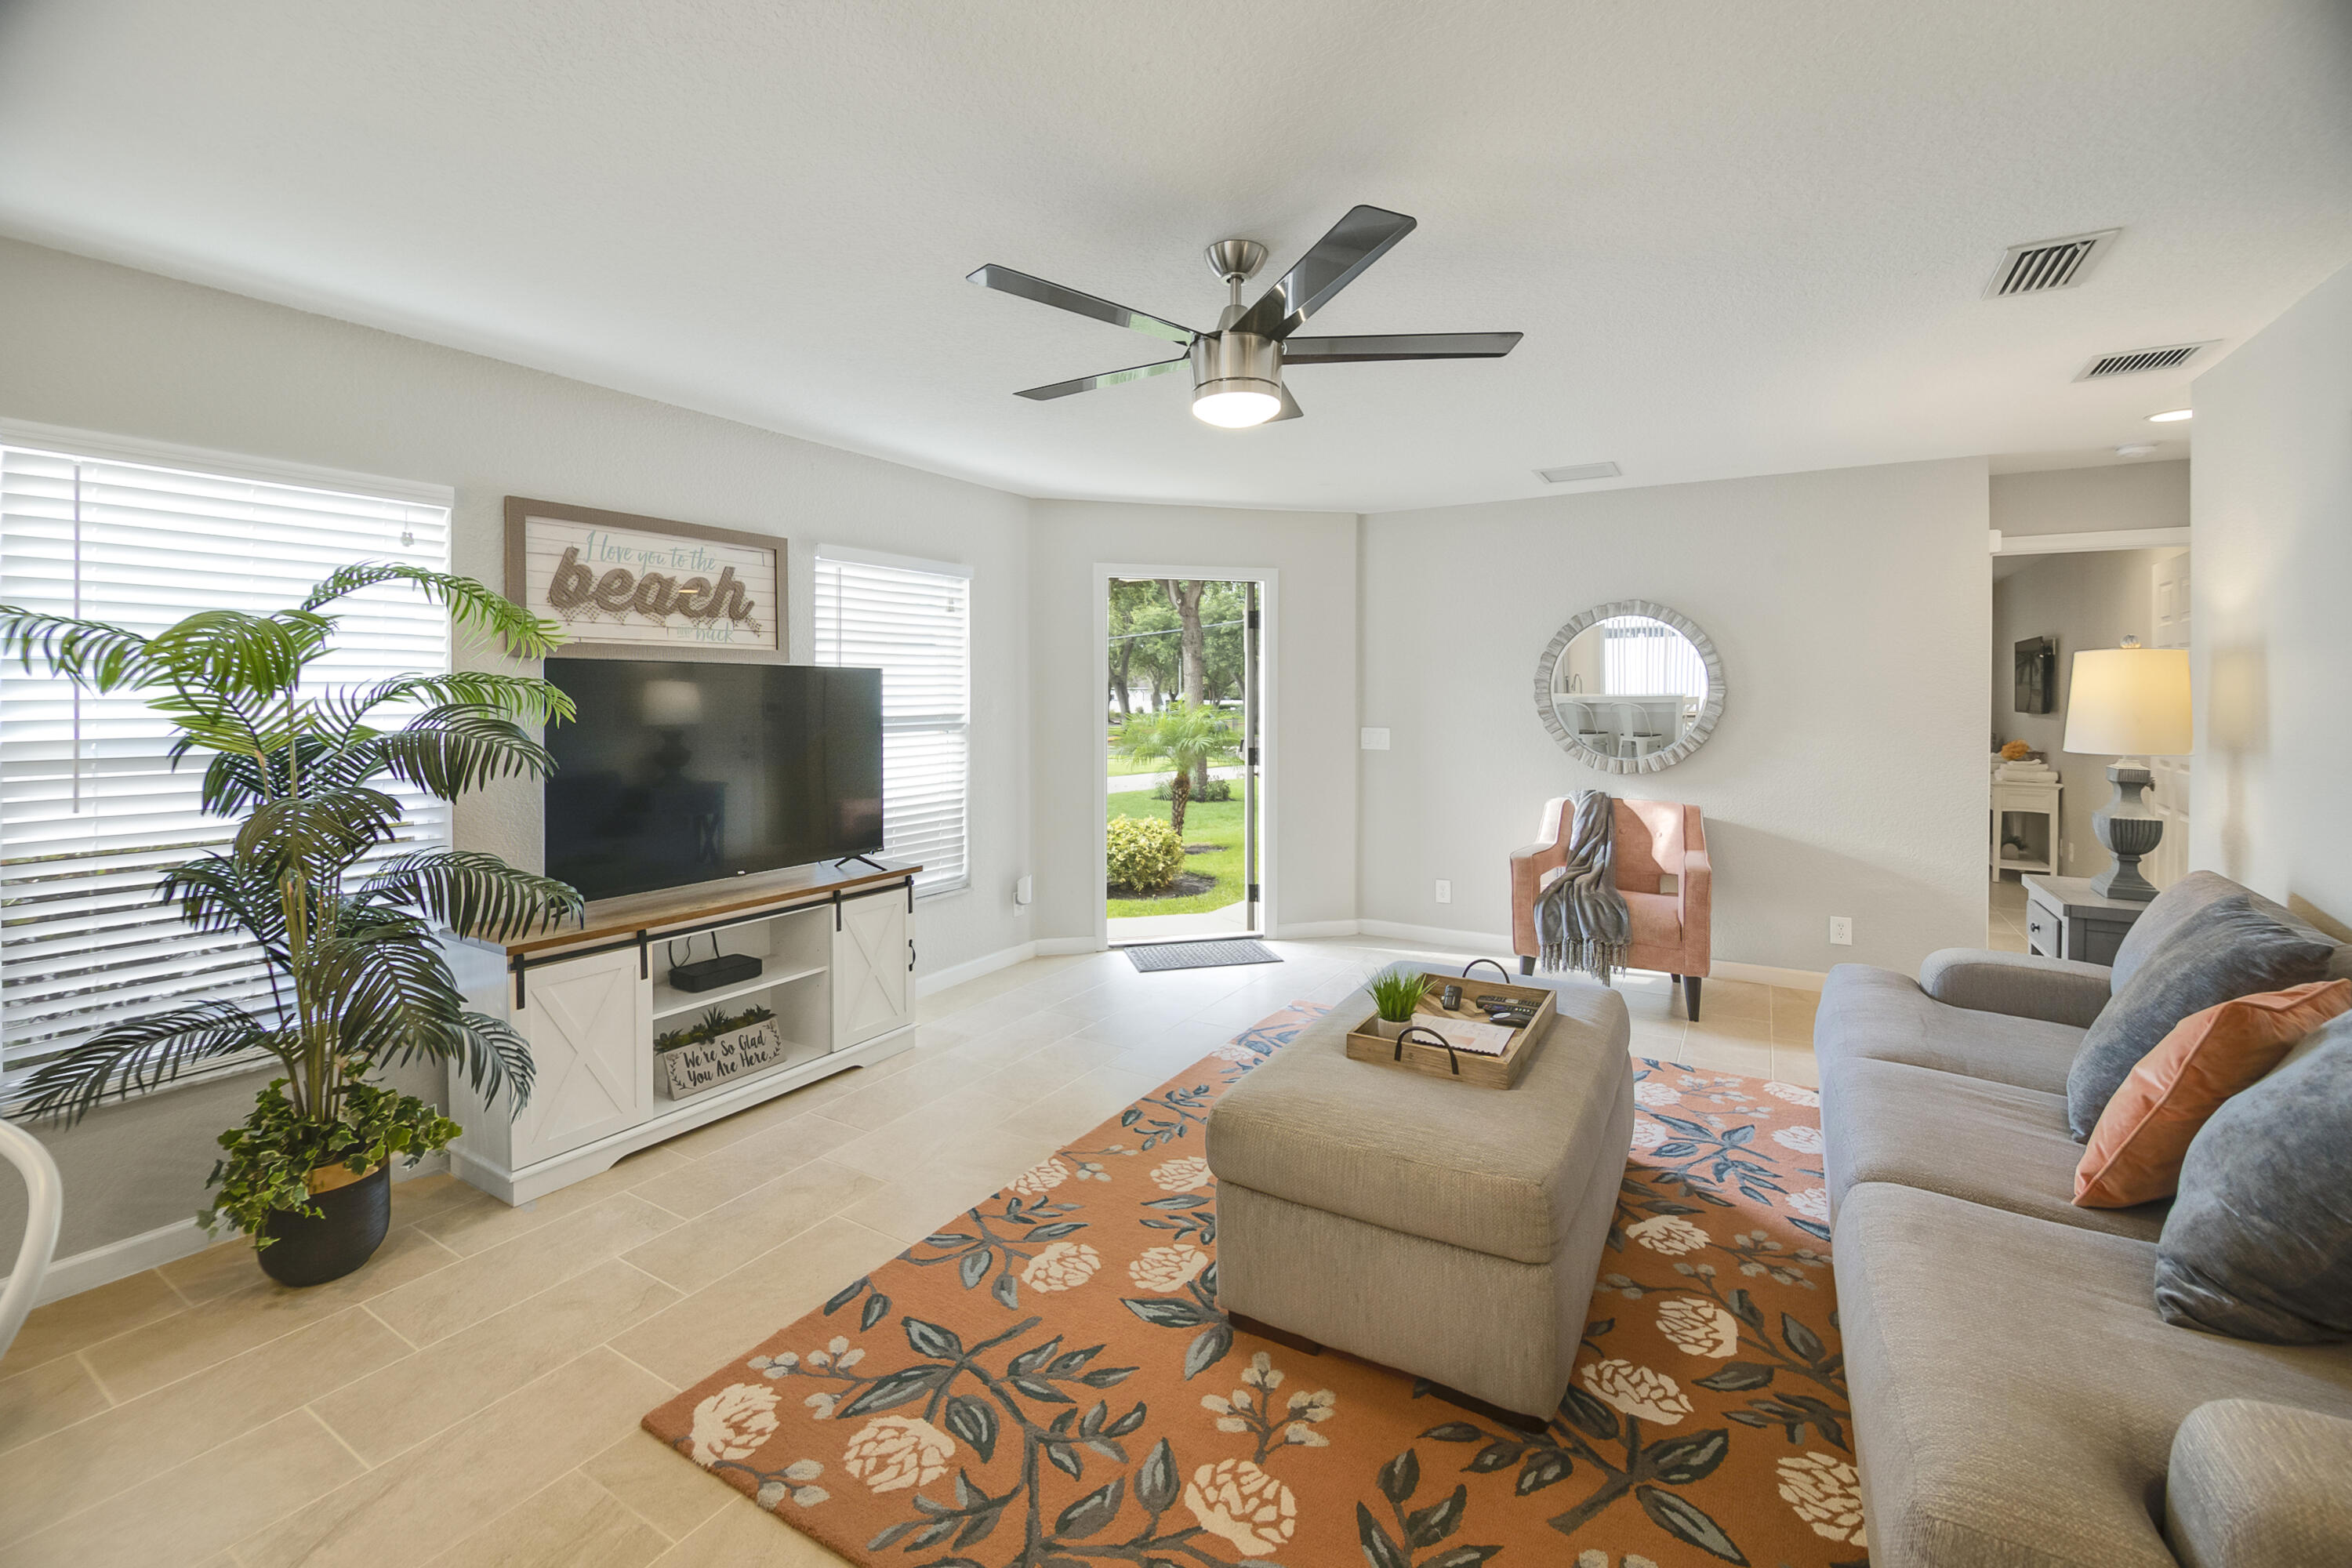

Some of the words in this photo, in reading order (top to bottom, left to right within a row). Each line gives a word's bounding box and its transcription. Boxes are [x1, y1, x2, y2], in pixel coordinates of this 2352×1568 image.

[585, 529, 596, 563] I
[601, 534, 633, 564] love
[637, 551, 666, 578] you
[670, 546, 689, 568] to
[689, 546, 716, 572] the
[549, 546, 755, 621] beach
[684, 1047, 717, 1068] We're
[720, 1040, 735, 1057] So
[739, 1029, 767, 1051] Glad
[687, 1070, 713, 1087] You
[717, 1059, 739, 1077] Are
[739, 1051, 771, 1067] Here.
